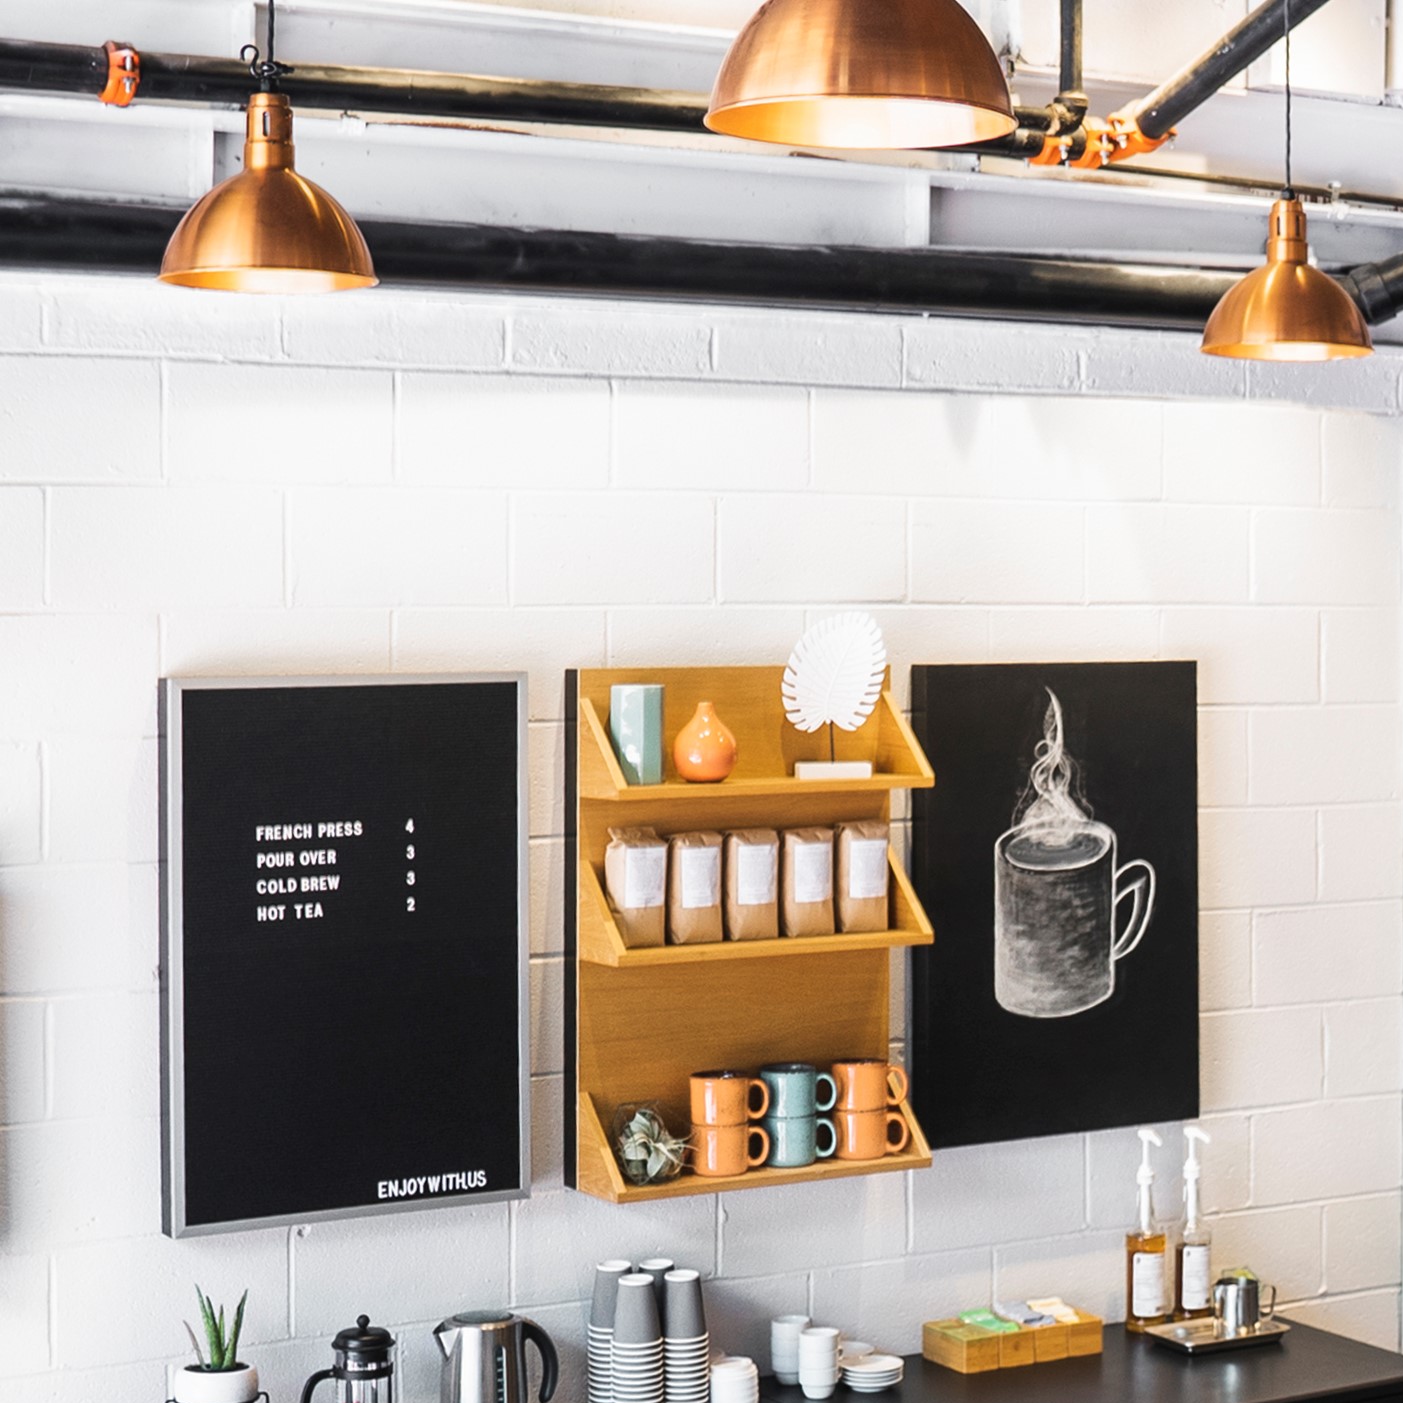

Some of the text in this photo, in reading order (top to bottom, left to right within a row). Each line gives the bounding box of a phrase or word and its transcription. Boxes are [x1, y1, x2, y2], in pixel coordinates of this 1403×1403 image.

[255, 818, 415, 842] FRENCH PRESS 4
[256, 844, 416, 869] POUR OVER 3
[256, 870, 416, 895] COLD BREW 3
[256, 896, 416, 922] HOT TEA 2
